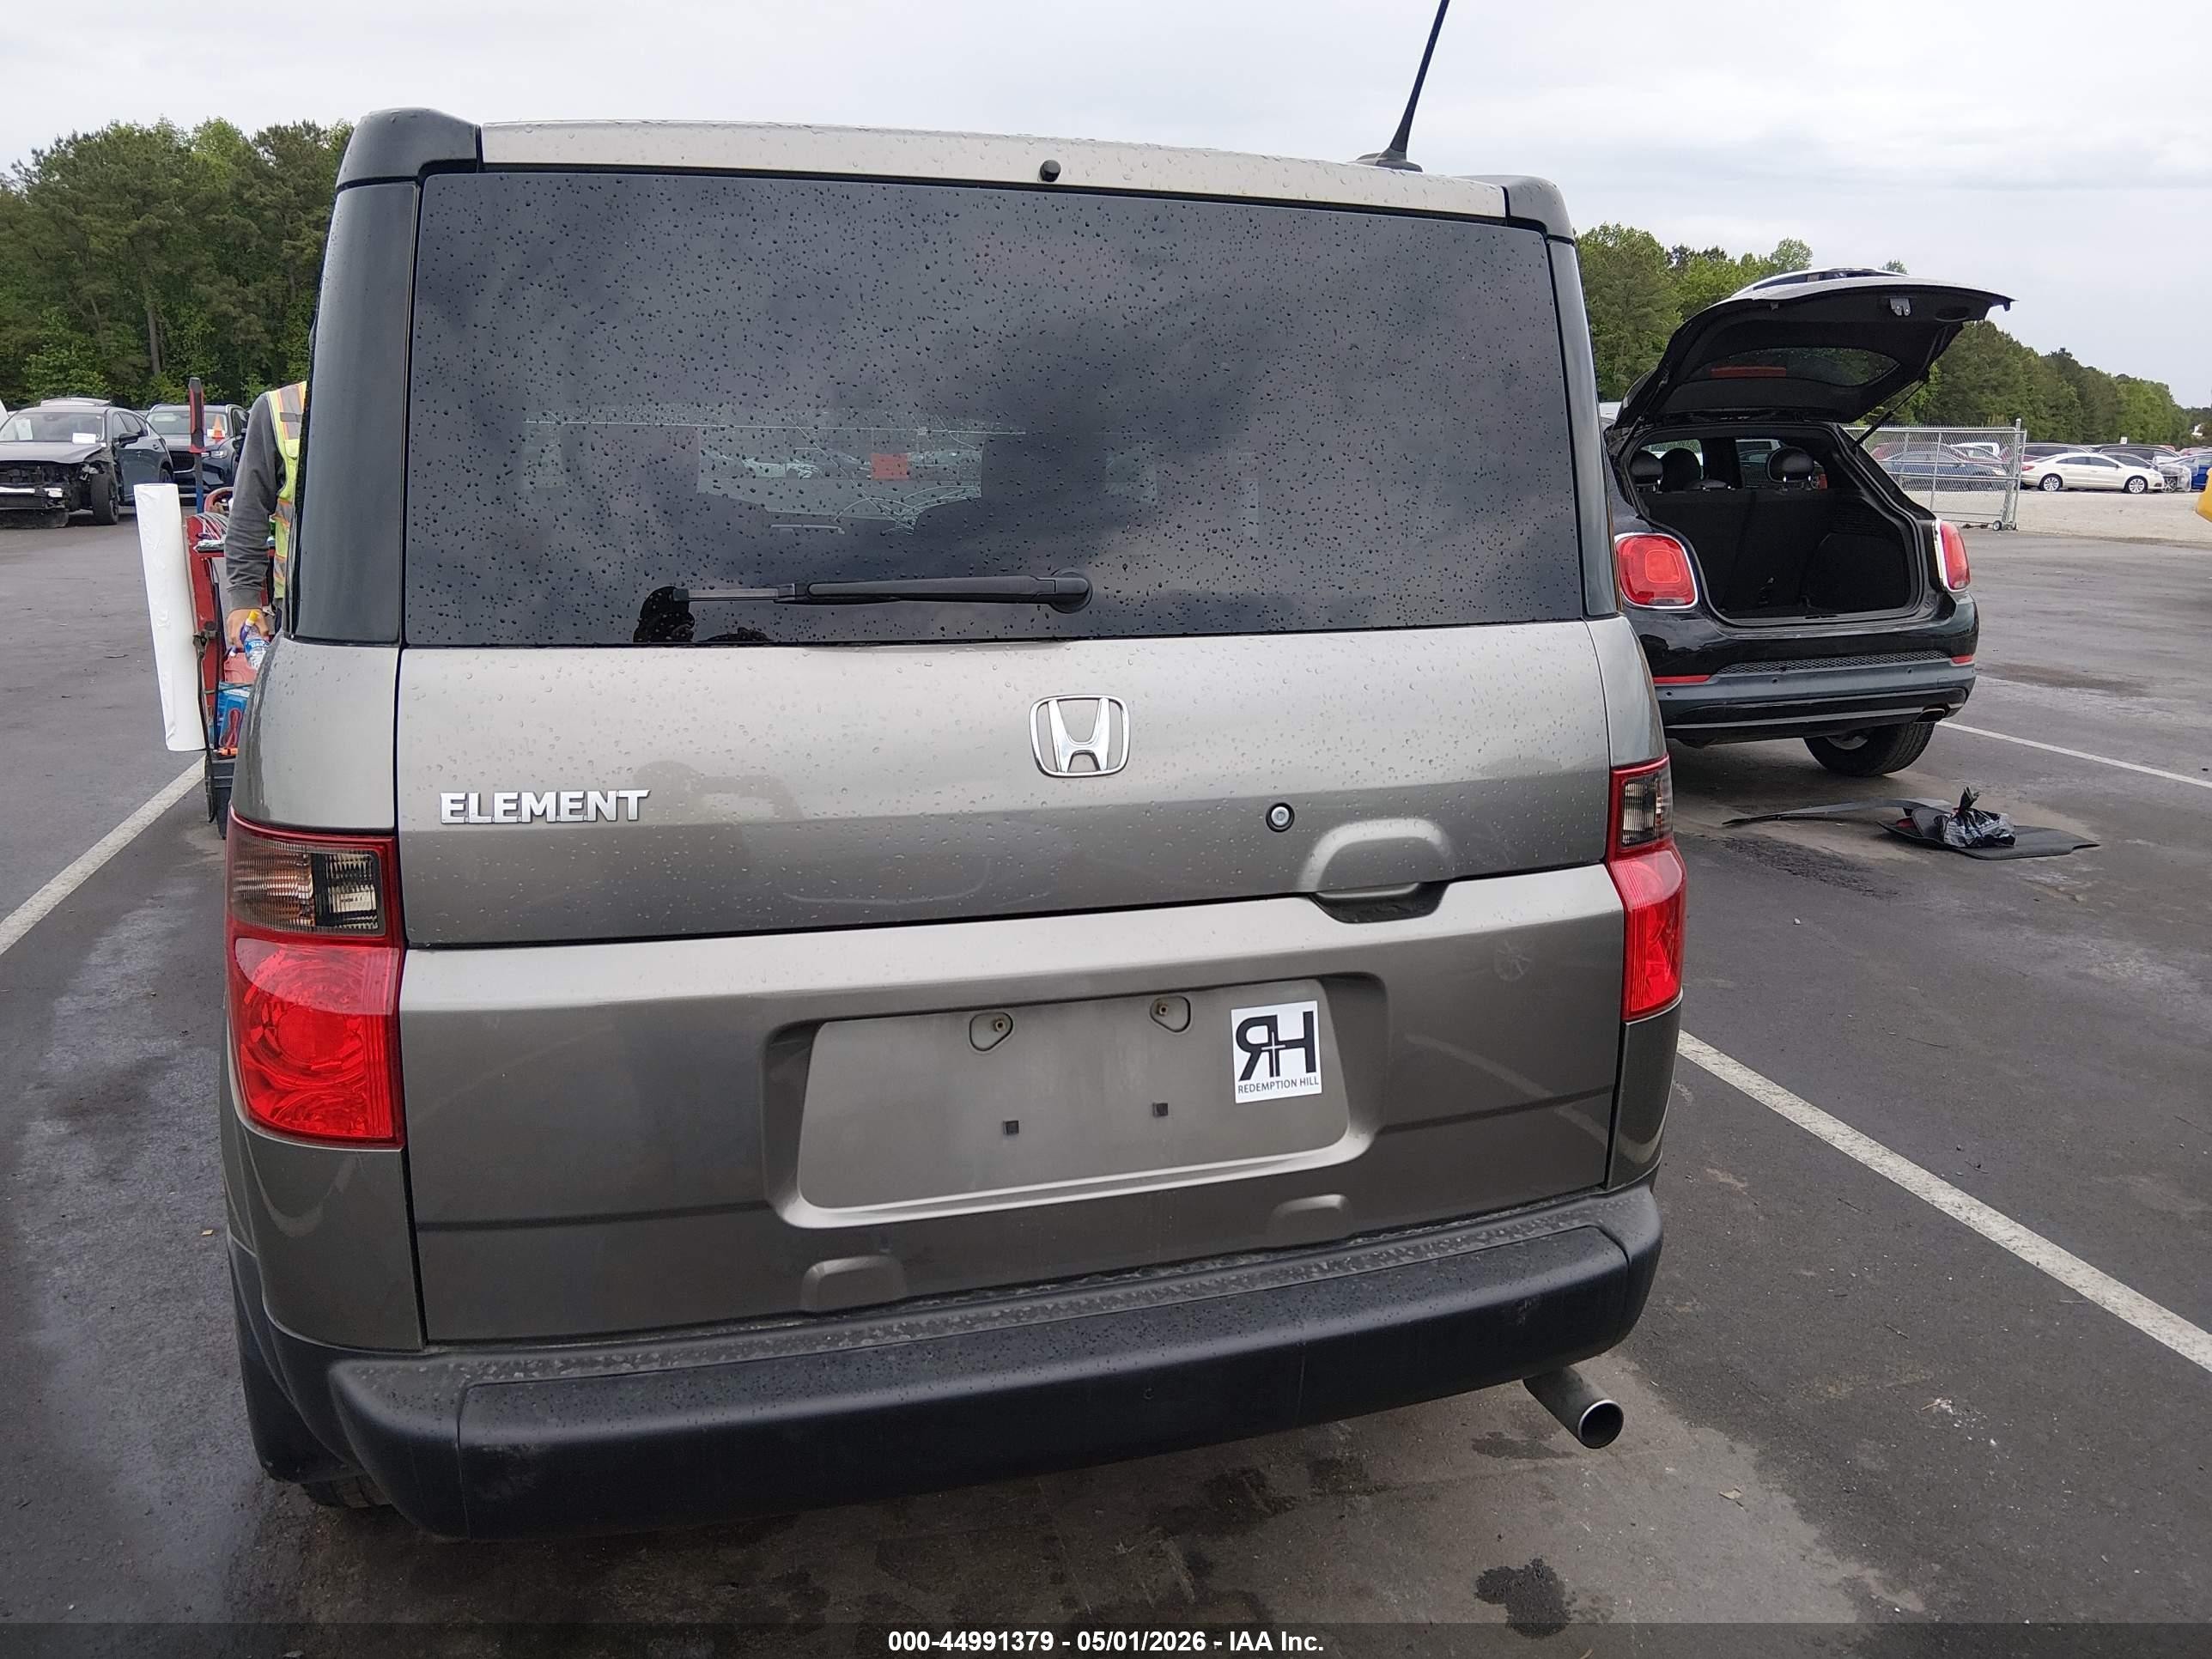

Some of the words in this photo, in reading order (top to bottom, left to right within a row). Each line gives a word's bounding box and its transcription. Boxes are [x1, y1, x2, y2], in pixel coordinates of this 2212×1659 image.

[440, 789, 651, 824] ELEMENT
[1237, 1079, 1297, 1094] REDEMPTION
[1299, 1076, 1319, 1087] HILL
